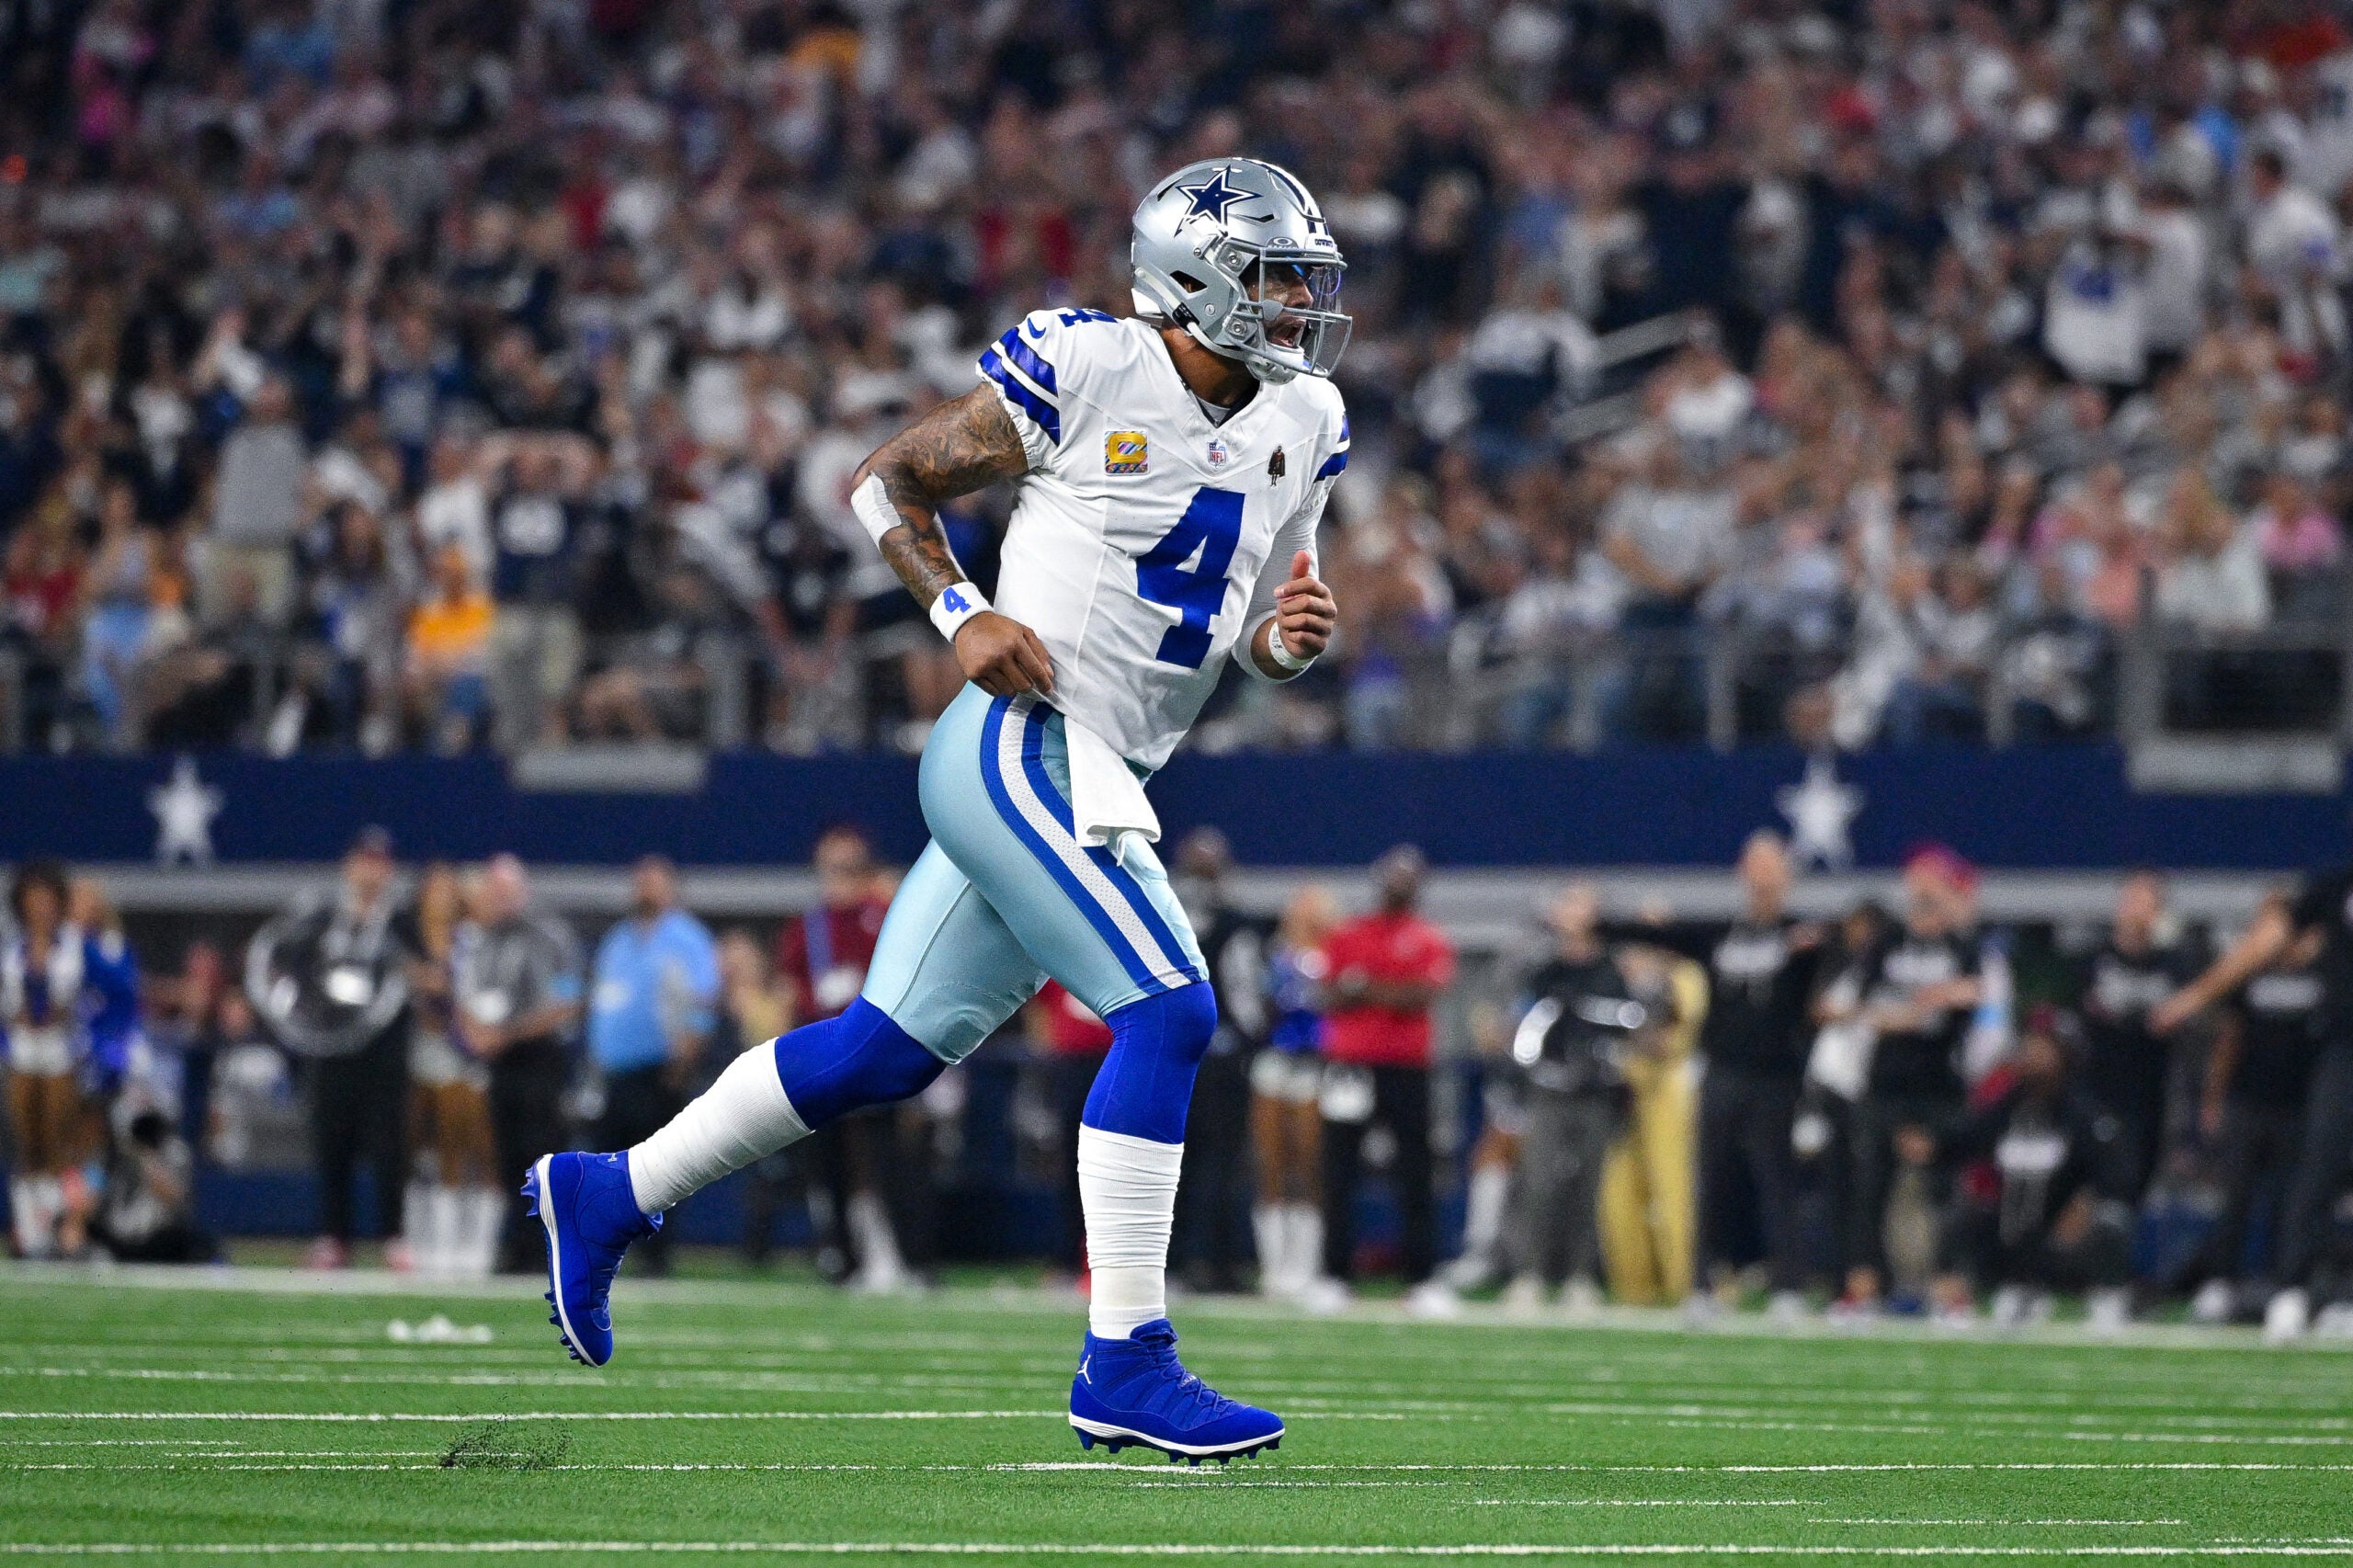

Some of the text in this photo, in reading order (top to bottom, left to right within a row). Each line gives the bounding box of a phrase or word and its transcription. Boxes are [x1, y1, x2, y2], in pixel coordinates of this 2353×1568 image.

[1108, 433, 1147, 463] C
[1210, 451, 1223, 463] NFL
[1136, 486, 1245, 669] 4
[943, 587, 972, 613] 4
